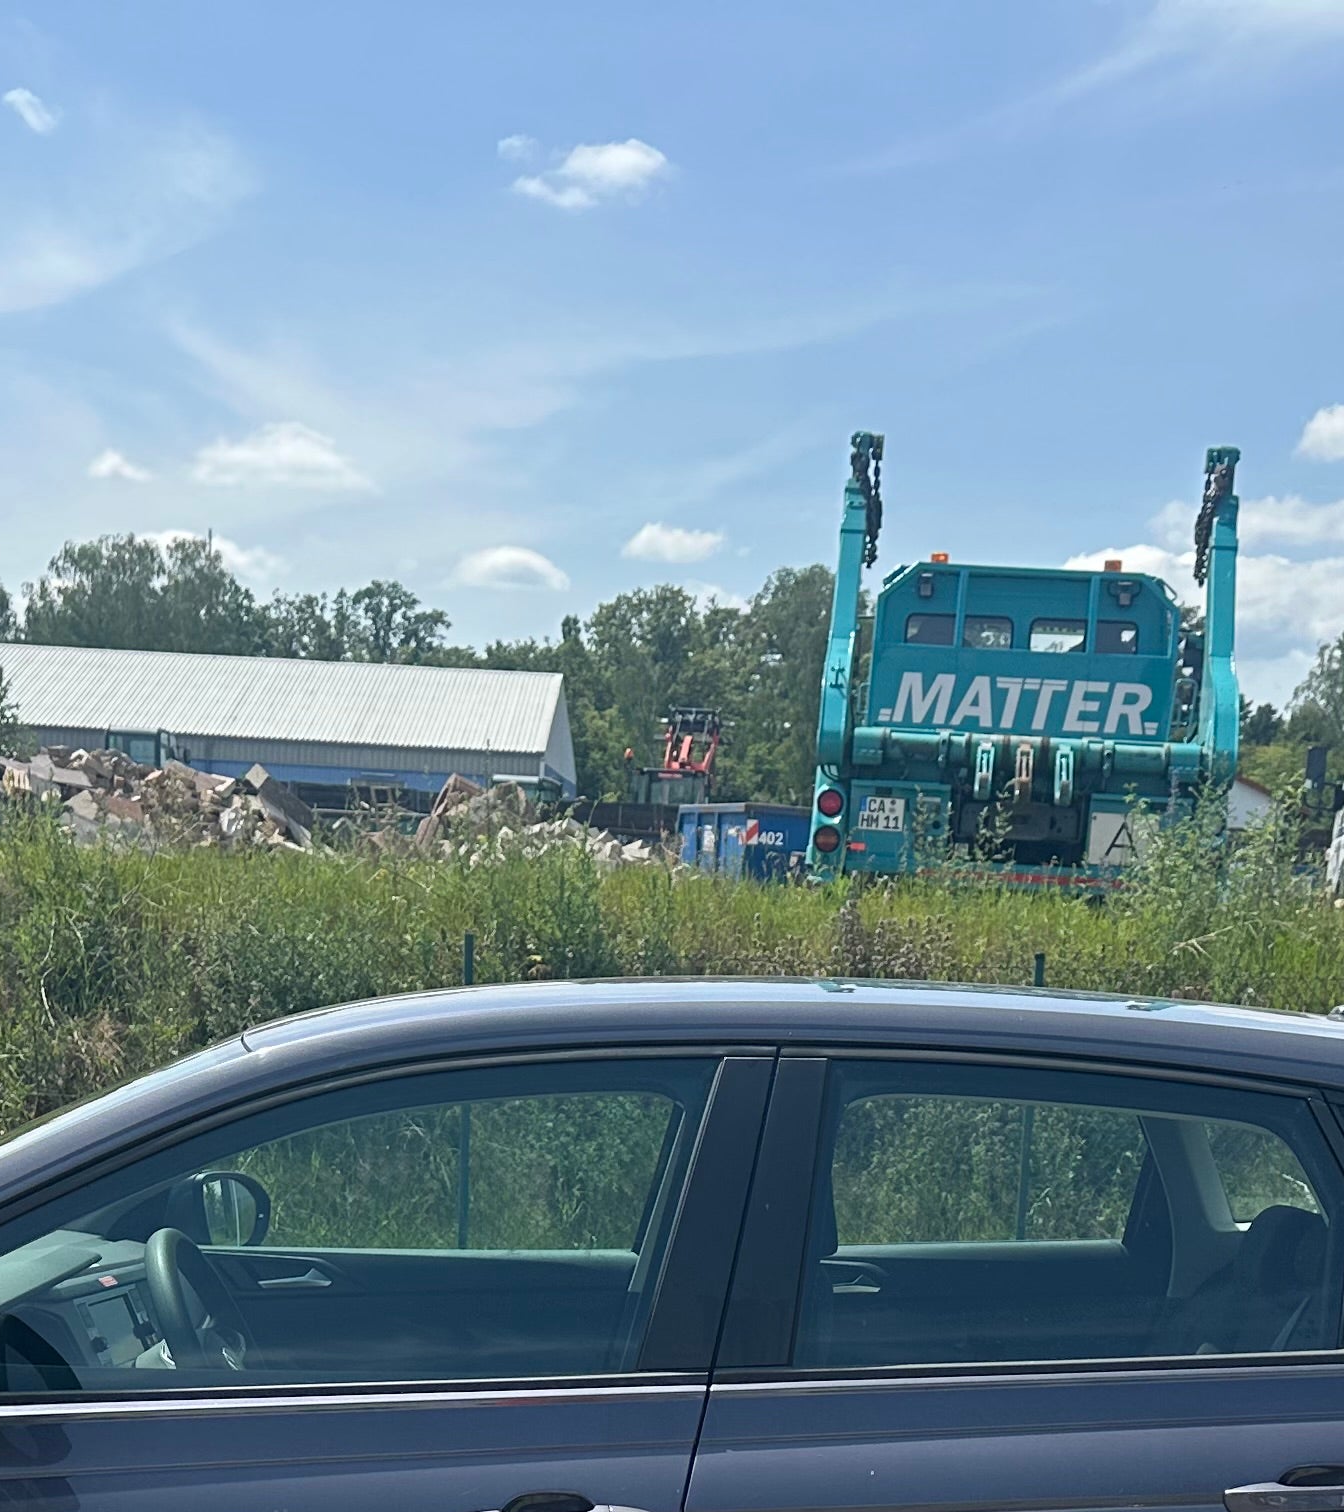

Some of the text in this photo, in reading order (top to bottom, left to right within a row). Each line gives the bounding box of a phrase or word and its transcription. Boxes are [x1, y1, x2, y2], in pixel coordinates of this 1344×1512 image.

[878, 671, 1158, 735] MATTER
[868, 798, 887, 814] CA
[860, 814, 900, 830] HM 11
[758, 830, 784, 846] 402
